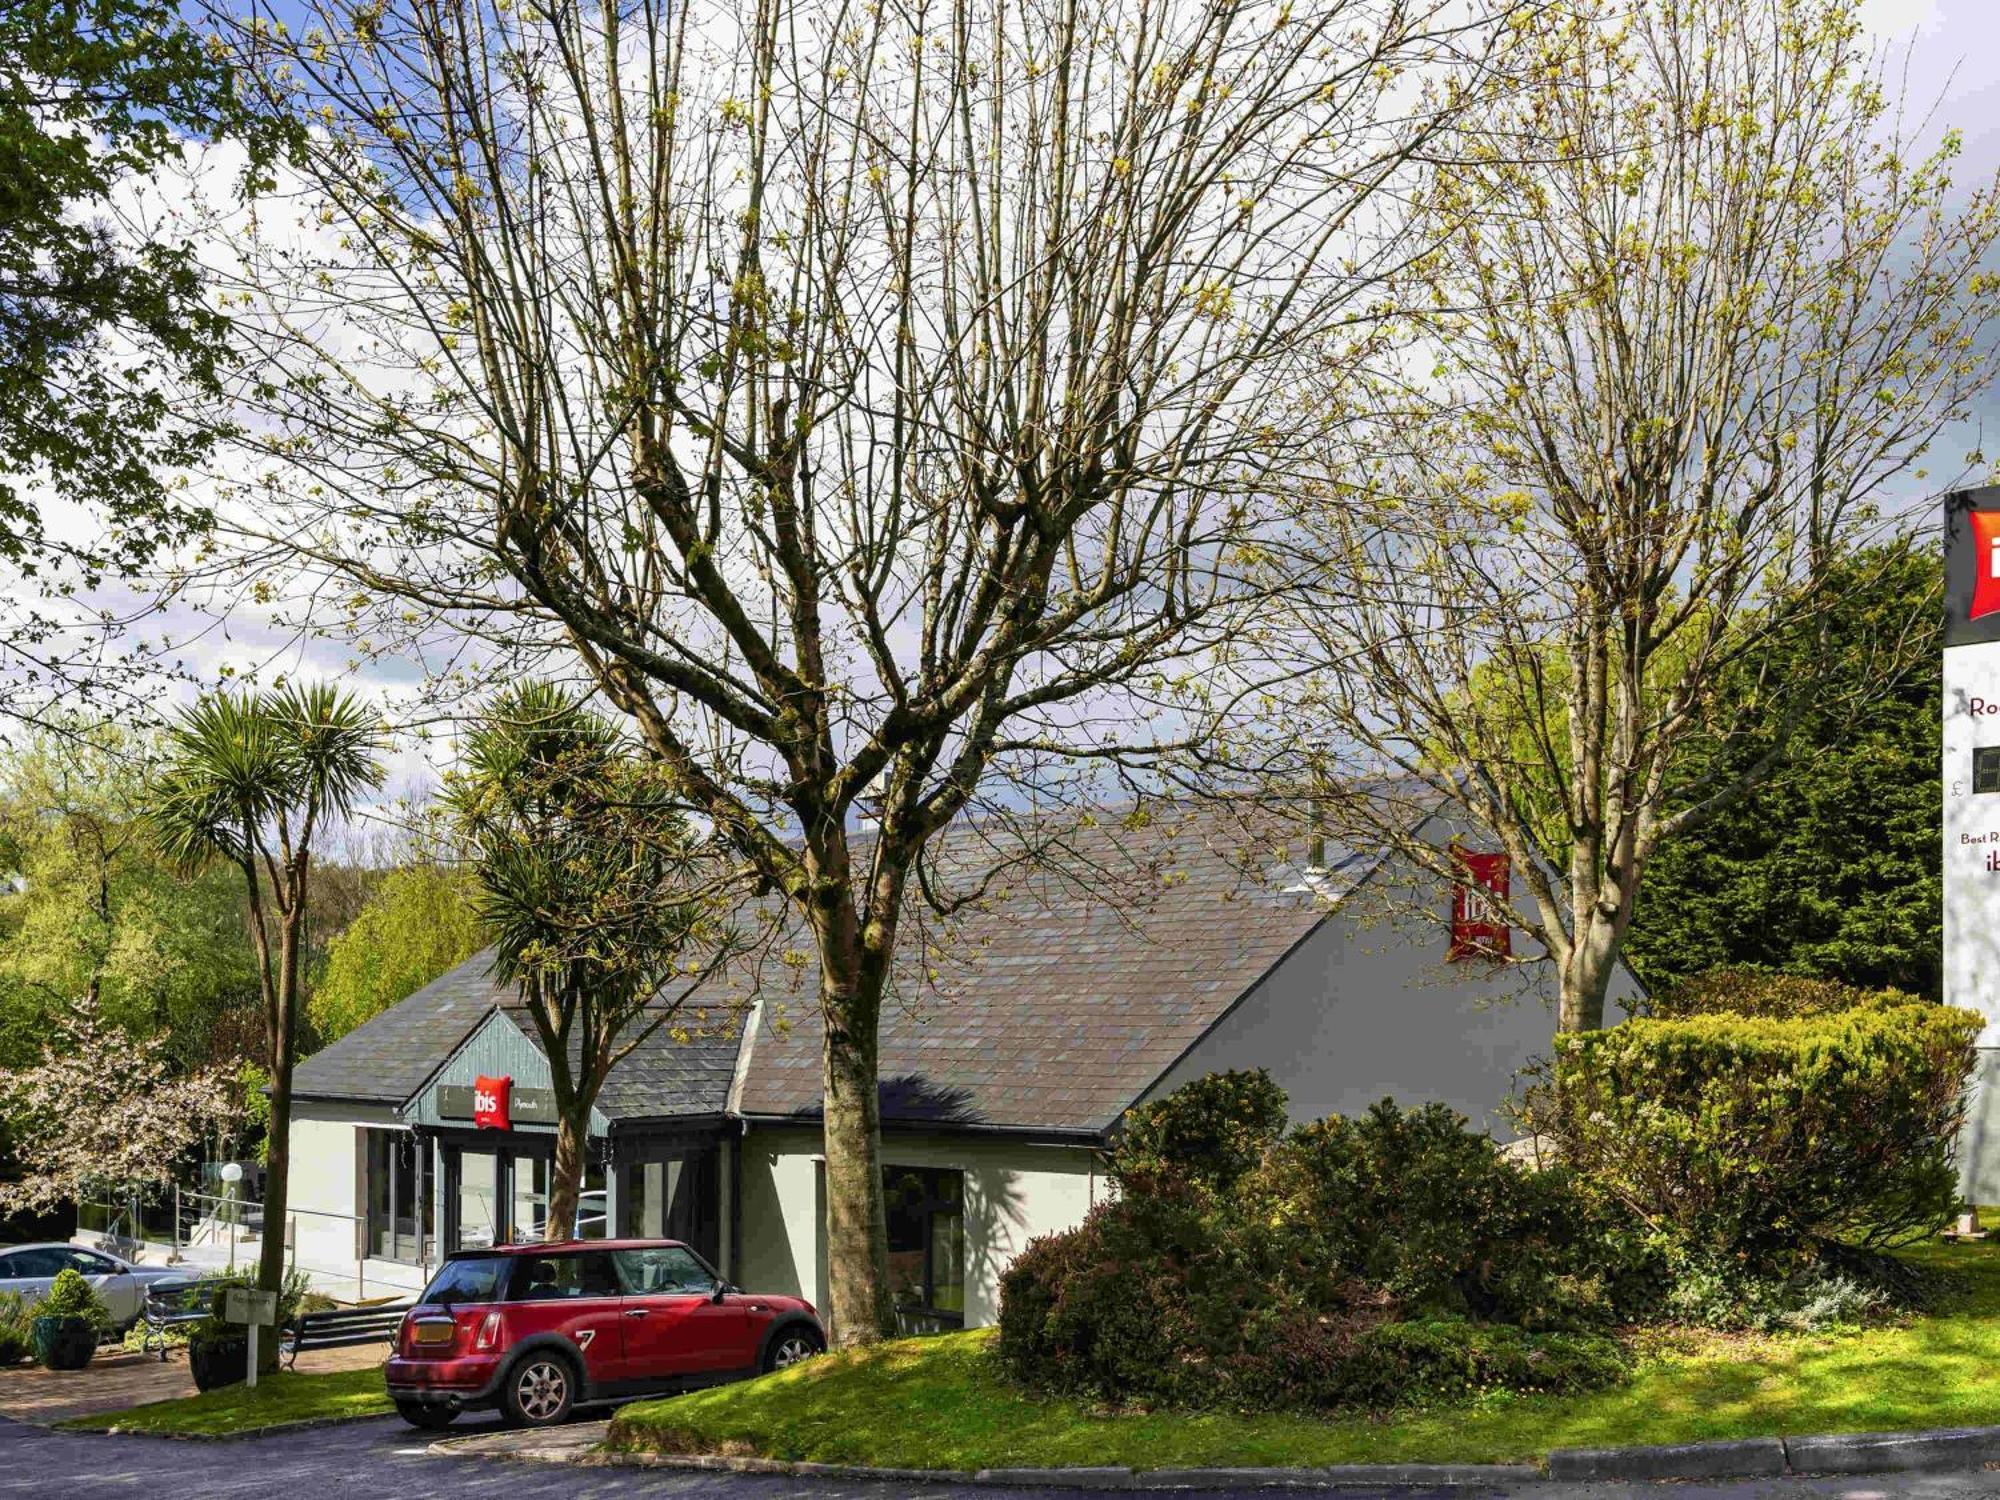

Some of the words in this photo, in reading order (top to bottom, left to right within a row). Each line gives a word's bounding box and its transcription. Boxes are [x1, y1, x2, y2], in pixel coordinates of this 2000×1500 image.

[1970, 698, 2000, 716] Ro
[1961, 833, 1987, 844] Best
[474, 1090, 497, 1113] ibis
